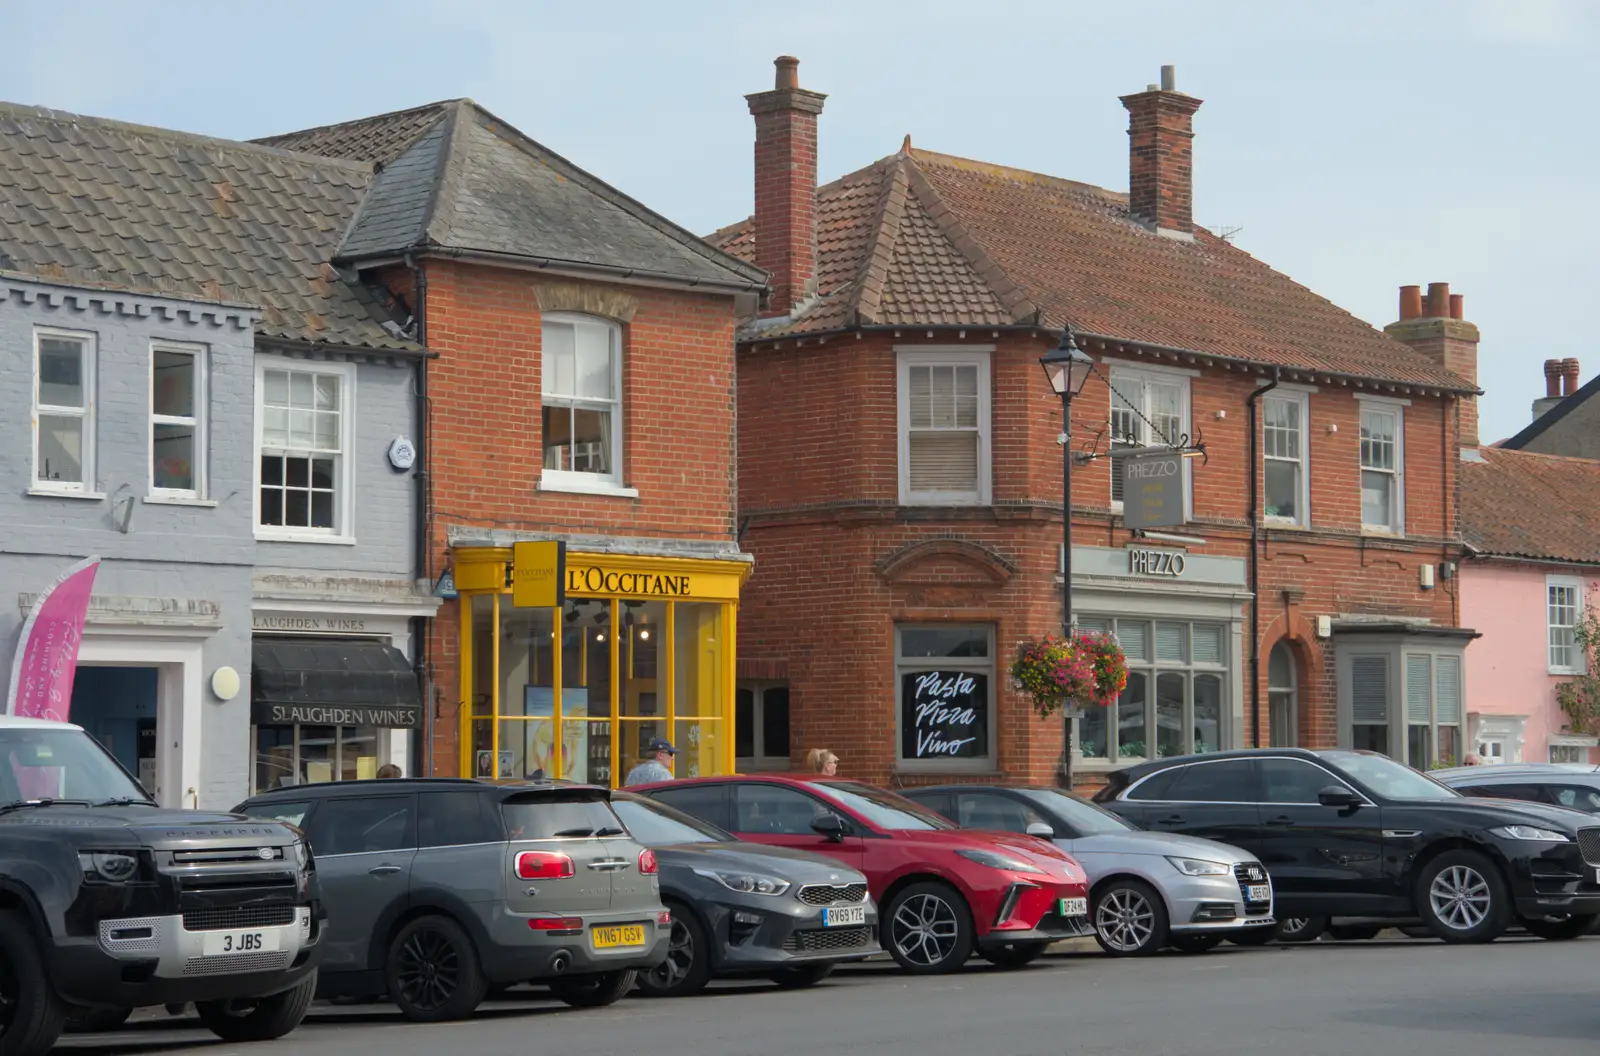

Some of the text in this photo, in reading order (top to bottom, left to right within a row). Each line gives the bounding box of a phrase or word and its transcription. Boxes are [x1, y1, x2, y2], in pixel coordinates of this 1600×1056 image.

[1128, 460, 1178, 479] PREZZO
[1130, 549, 1186, 576] PREZZO
[568, 565, 691, 596] L'OCCITANE
[252, 616, 365, 631] LAUGHDEN WINES
[41, 620, 57, 673] CLOTHING
[915, 671, 977, 699] Pasta
[272, 705, 416, 726] SLAUGHDEN WINES
[915, 699, 977, 727] Pizza
[916, 729, 977, 758] Vino
[829, 907, 863, 924] RV69 YZE
[223, 933, 262, 952] 3 JBS
[597, 926, 641, 944] YN67 GSV
